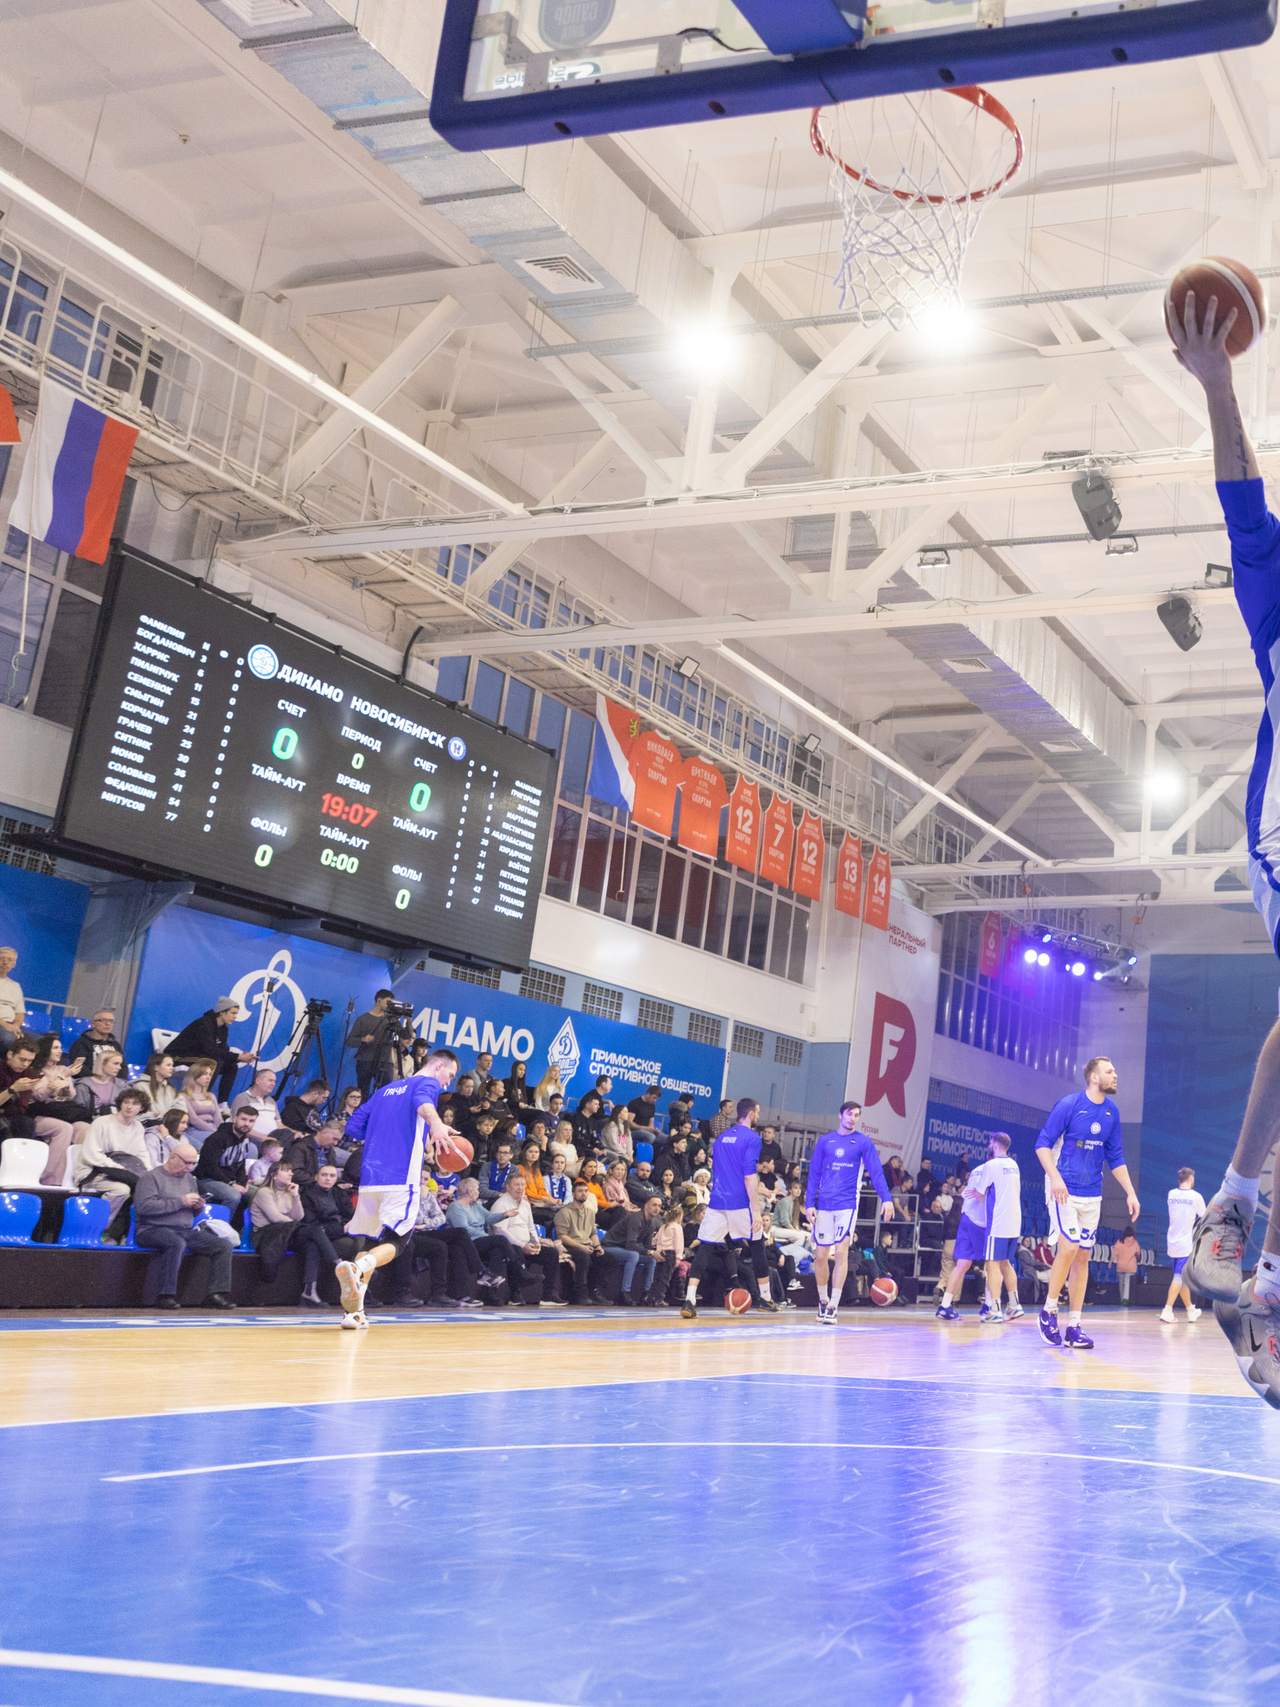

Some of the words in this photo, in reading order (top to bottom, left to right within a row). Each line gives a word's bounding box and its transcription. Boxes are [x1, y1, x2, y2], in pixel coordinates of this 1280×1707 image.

[140, 615, 186, 640] ФАМИЛИЯ
[136, 627, 196, 658] БОГДАНОВИЧ
[200, 655, 207, 663] 3
[133, 641, 170, 662] ХАРРИС
[197, 669, 204, 677] 6
[130, 656, 180, 682] ПИЛИПЧУК
[194, 682, 202, 692] 11
[127, 671, 174, 696] СЕМЕНЮК
[190, 696, 200, 706] 15
[124, 686, 164, 708] СМЫГИН
[186, 711, 198, 720] 21
[277, 664, 344, 702] ДИНАМО
[350, 696, 446, 748] НОВОСИБИРСК
[277, 699, 306, 718] СЧЕТ
[120, 700, 169, 725] КОРЧАГИН
[182, 724, 195, 735] 24
[117, 716, 152, 734] ГРАЧЕВ
[180, 739, 192, 749] 25
[272, 728, 300, 760] 0
[341, 726, 382, 752] ПЕРИОД
[114, 731, 153, 750] СИТНИК
[177, 753, 190, 763] 30
[110, 745, 144, 763] ИОНОВ
[174, 768, 186, 778] 36
[352, 753, 364, 769] 0
[414, 757, 438, 773] СЧЕТ
[108, 761, 156, 783] СОЛОВЬЕВ
[172, 783, 183, 792] 41
[252, 763, 306, 792] ТАЙМ-АУТ
[336, 773, 371, 794] ВРЕМЯ
[648, 768, 668, 786] СПАРТАК
[104, 776, 157, 800] ФЕДЮШИН
[168, 797, 180, 807] 54
[410, 783, 431, 812] 0
[692, 793, 712, 808] СПАРТАК
[101, 791, 146, 812] МИТУСОВ
[165, 812, 178, 821] 77
[322, 793, 377, 827] 19:07
[250, 817, 288, 837] ФОЛЫ
[393, 816, 438, 840] ТАЙМ-АУТ
[506, 812, 536, 828] МАРТЫНОВ
[736, 806, 754, 834] 12
[320, 825, 369, 850] ТАЙМ-АУТ
[774, 823, 784, 848] 7
[254, 845, 273, 867] 0
[321, 849, 359, 874] 0:00
[802, 838, 818, 866] 12
[392, 864, 422, 882] ФОЛЫ
[500, 870, 528, 885] ПЕТРОВИЧ
[508, 861, 530, 874] ВОЙТОВ
[844, 859, 858, 884] 13
[874, 873, 886, 898] 14
[395, 889, 410, 909] 0
[494, 904, 523, 919] КУРЦЕВИЧ
[500, 894, 524, 908] ТУМАНОВ
[888, 923, 926, 949] НЕРАЛЬНЫЙ
[889, 935, 918, 954] ПАРТНЕР
[988, 932, 995, 950] 6
[403, 1007, 534, 1061] ИНАМО
[590, 1048, 662, 1074] ПРИМОРСКОЕ
[590, 1062, 658, 1086] СПОРТИВНОЕ
[660, 1076, 712, 1098] ОБЩЕСТВО
[928, 1118, 994, 1144] ПРАВИТЕЛЬСТ
[928, 1136, 988, 1160] ПРИМОРСКОГ
